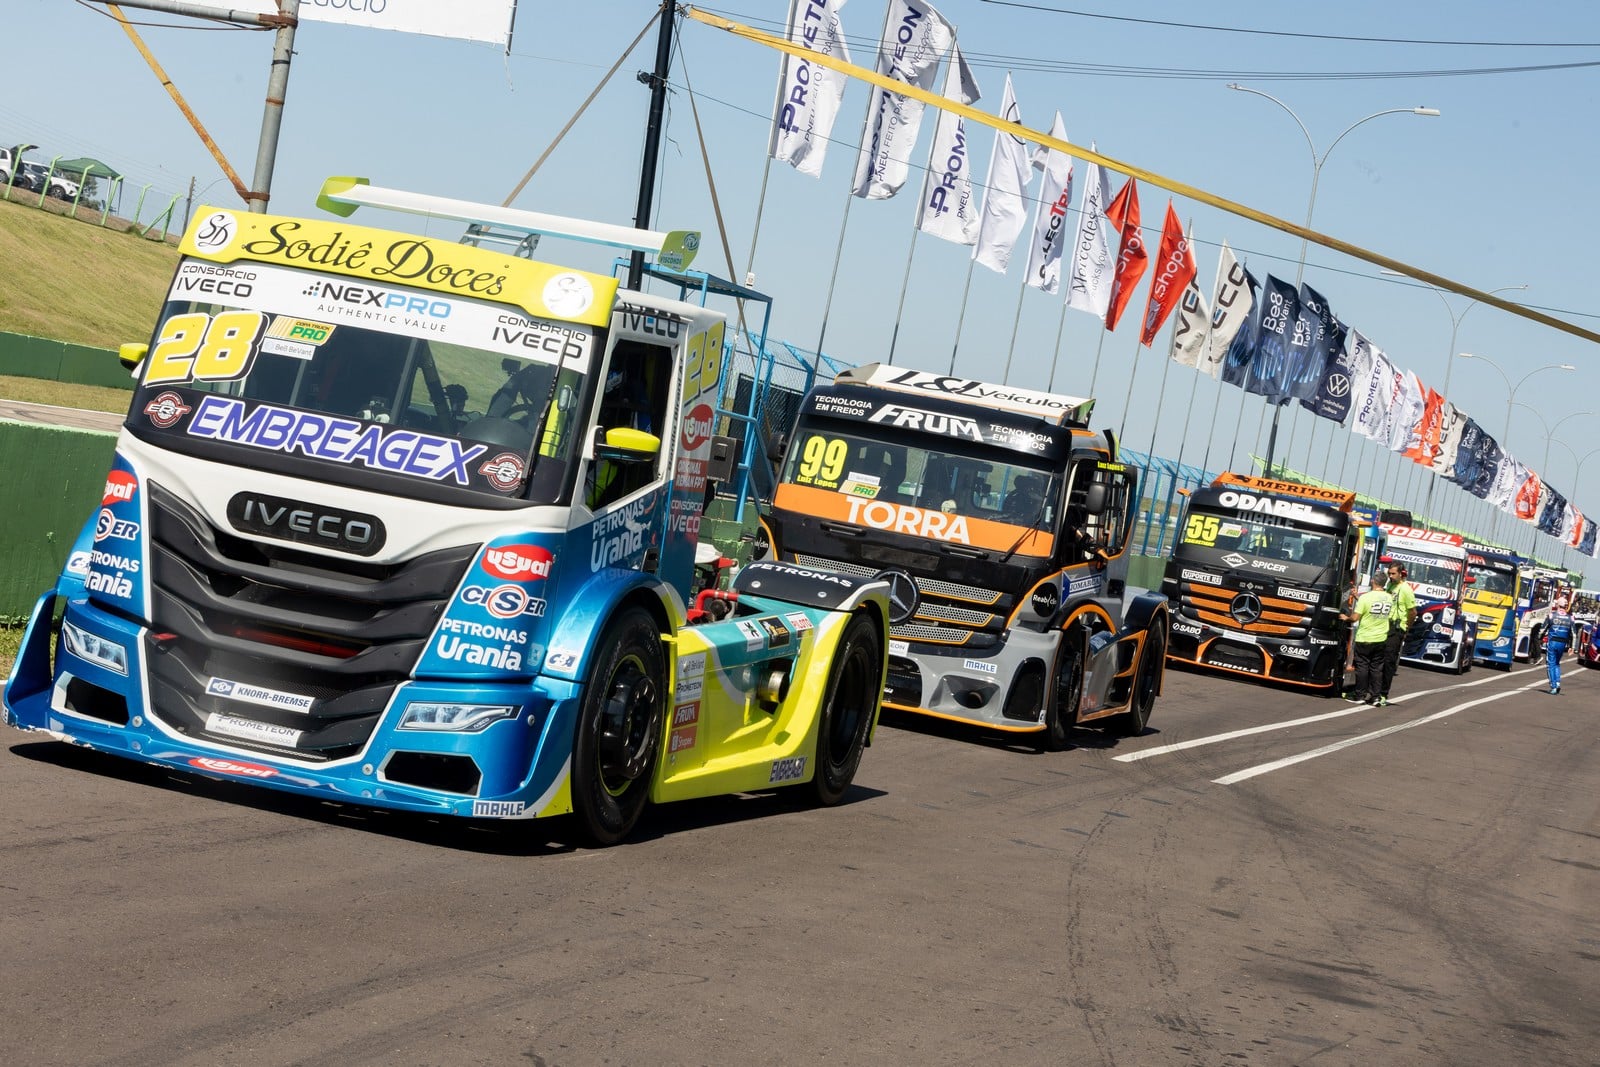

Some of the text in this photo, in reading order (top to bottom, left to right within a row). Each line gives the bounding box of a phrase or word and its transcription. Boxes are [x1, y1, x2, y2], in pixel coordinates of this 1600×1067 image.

[244, 221, 372, 270] Sodiê
[371, 238, 508, 296] Doces
[182, 263, 257, 282] CONSÓRCIO
[177, 276, 254, 298] IVECO
[321, 281, 452, 319] NEXPRO
[317, 303, 448, 333] AUTHENTIC VALUE
[1263, 291, 1284, 332] Be8
[1275, 298, 1296, 336] BeVant
[289, 325, 327, 341] PRO
[498, 314, 588, 342] CONSÓRCIO
[142, 311, 270, 388] 28
[492, 326, 583, 360] IVECO
[684, 320, 726, 407] 28
[814, 395, 873, 410] TECNOLOGIA
[815, 403, 865, 417] EM FREIOS
[868, 403, 984, 442] FRUM
[989, 423, 1053, 444] TECNOLOGIA
[187, 395, 488, 486] EMBREAGEX
[992, 433, 1046, 451] EM FOS
[800, 435, 848, 480] 99
[853, 485, 876, 497] PRO
[1255, 479, 1346, 501] MERITOR
[243, 499, 372, 544] IVECO
[592, 497, 645, 540] PETRONAS
[667, 514, 701, 533] IVECO
[846, 496, 971, 545] TORRA
[1187, 514, 1220, 541] 55
[487, 549, 551, 579] usual
[748, 563, 853, 588] PETRONAS
[1251, 560, 1287, 573] SPICER
[84, 572, 132, 598] rania
[461, 586, 546, 616] CISER
[440, 618, 528, 644] PETRONAS
[436, 634, 522, 671] Urania
[965, 660, 996, 673] MAHLE
[1208, 660, 1259, 673] MAHLE
[237, 687, 311, 708] KNORR-BREMSE
[674, 704, 696, 724] FRUM
[197, 757, 275, 777] usual
[474, 801, 524, 816] MAHLE
